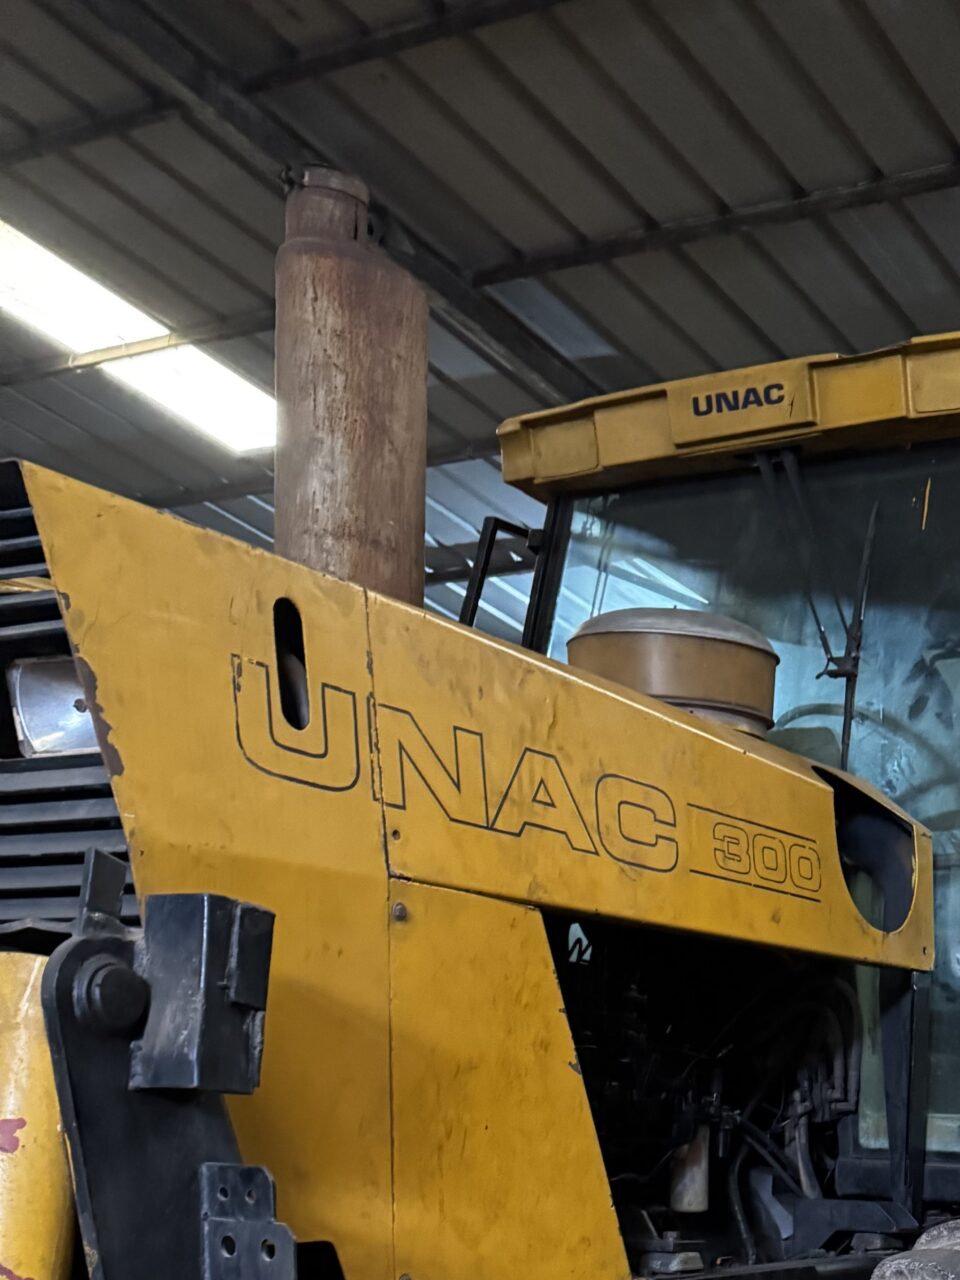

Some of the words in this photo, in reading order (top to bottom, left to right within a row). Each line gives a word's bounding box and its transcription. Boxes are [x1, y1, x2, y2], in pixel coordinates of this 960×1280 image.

[692, 383, 785, 417] UNAC
[231, 653, 679, 873] UNAC
[713, 822, 822, 893] 300
